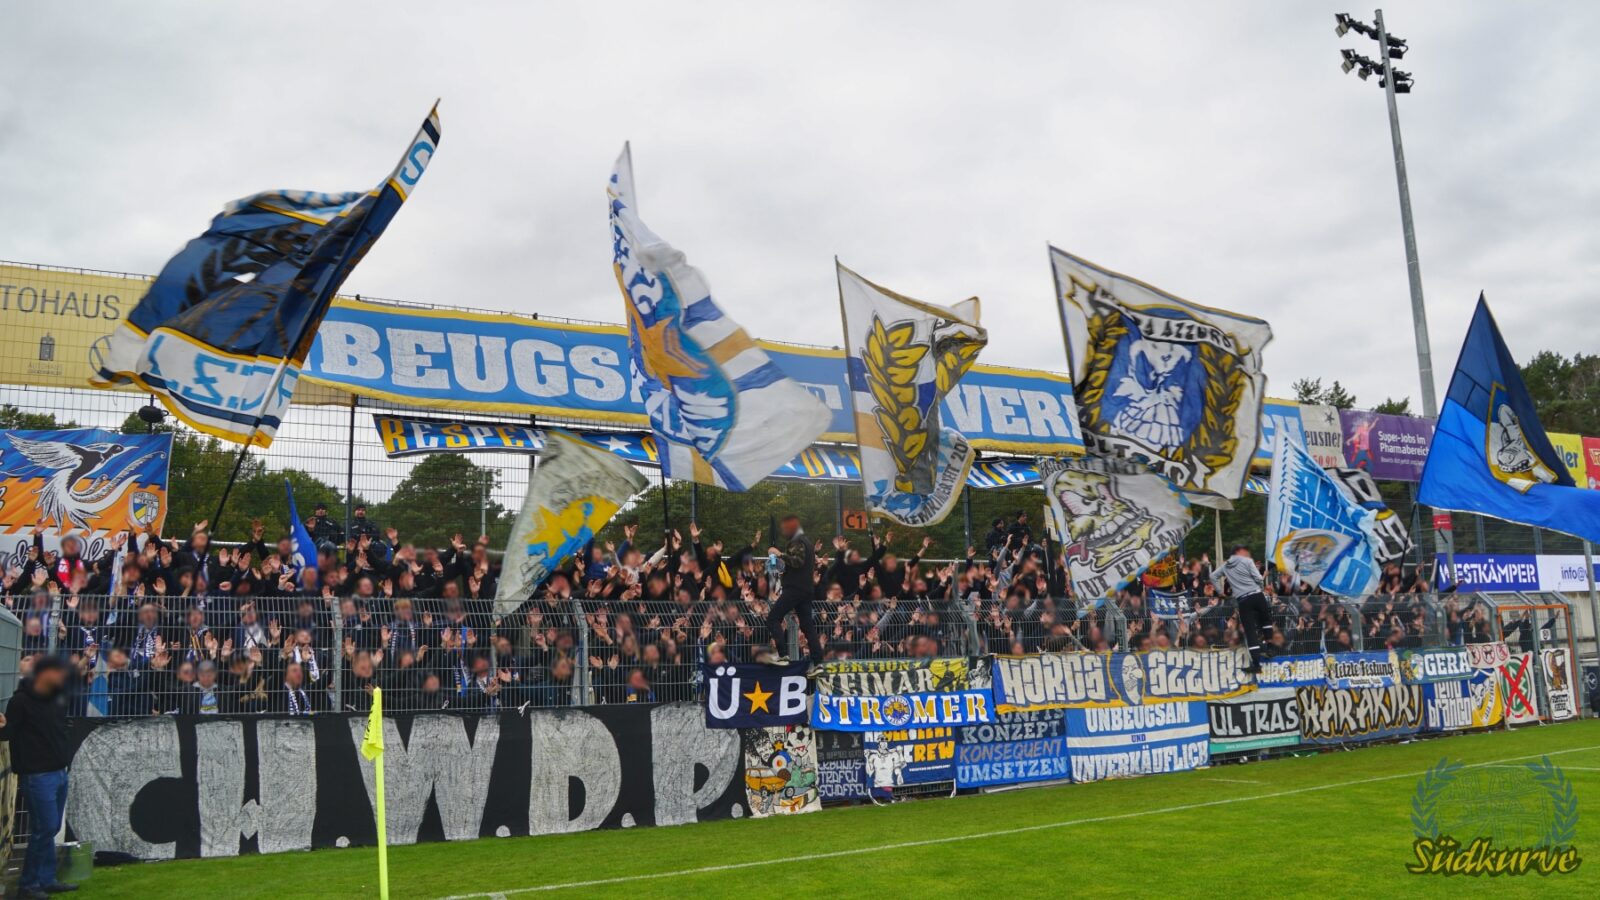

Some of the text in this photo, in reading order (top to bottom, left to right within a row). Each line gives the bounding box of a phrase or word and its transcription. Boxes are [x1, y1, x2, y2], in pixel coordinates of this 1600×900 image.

[845, 514, 865, 529] C1
[1424, 650, 1473, 677] GERA
[709, 666, 808, 720] Ü B
[1084, 701, 1191, 733] UNBEUGSAM
[1209, 699, 1299, 738] ULTRAS
[961, 720, 1061, 745] KONZEPT
[1130, 733, 1147, 744] UND
[959, 738, 1063, 764] KONSEQUENT
[1070, 738, 1209, 784] UNVERKÄUFLICH
[956, 756, 1068, 784] UMSETZEN
